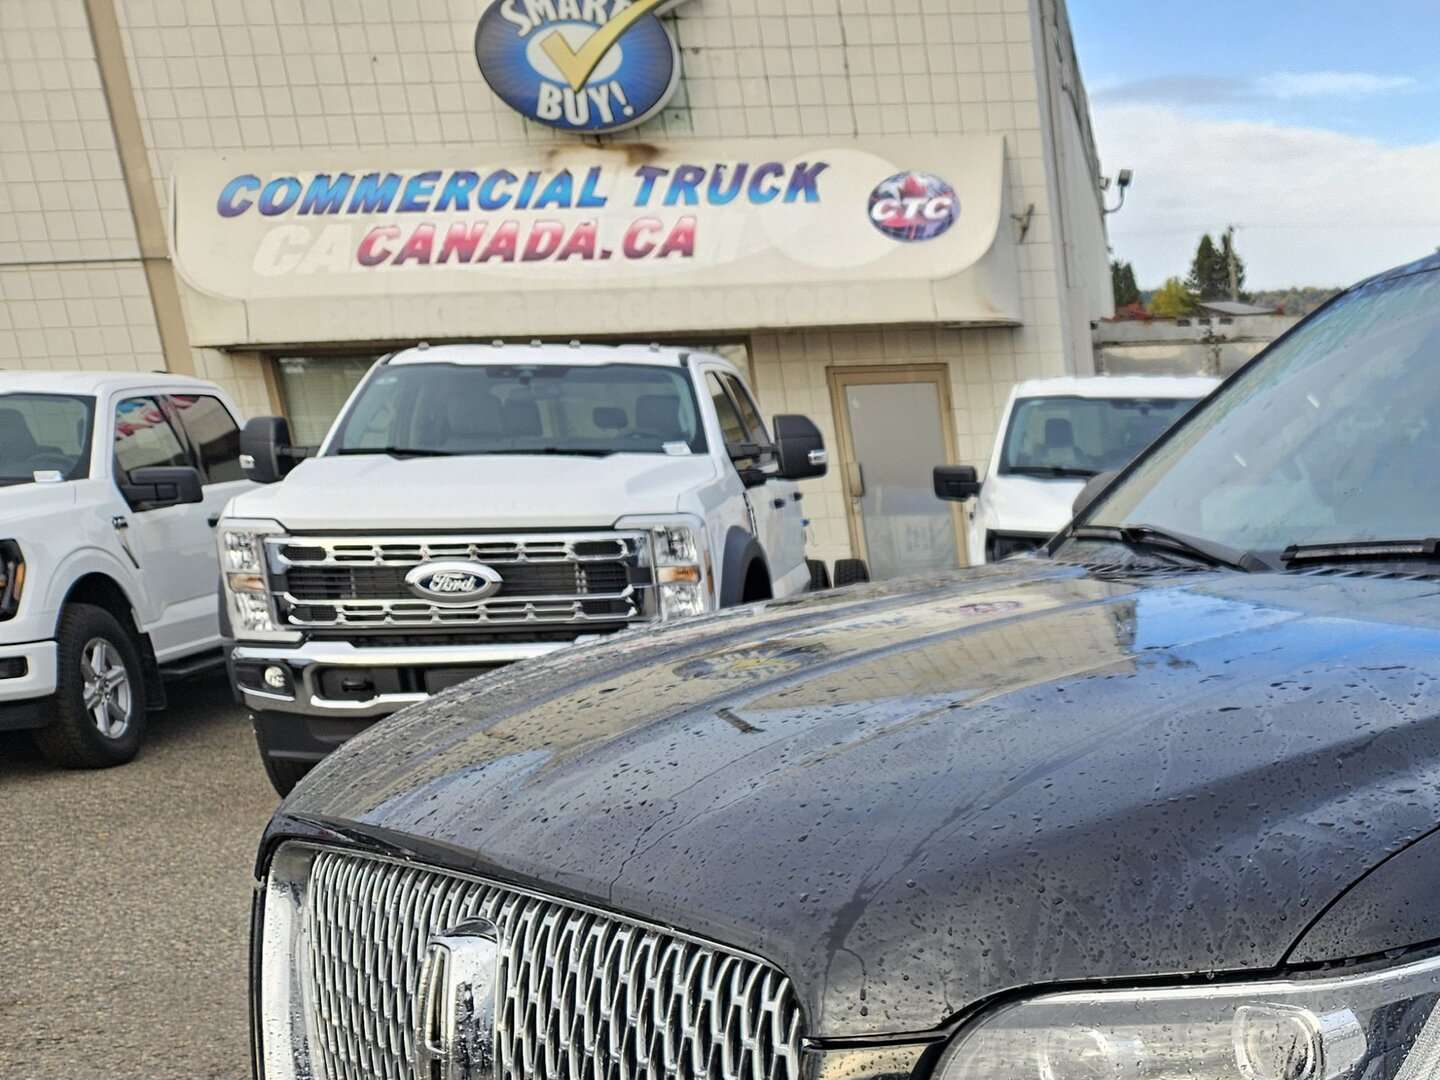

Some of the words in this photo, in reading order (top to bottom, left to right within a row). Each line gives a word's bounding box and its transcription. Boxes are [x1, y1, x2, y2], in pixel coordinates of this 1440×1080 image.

[536, 80, 634, 126] BUY!
[216, 165, 609, 218] COMMERCIAL
[633, 161, 830, 208] TRUCK
[871, 197, 952, 221] CTC
[356, 214, 698, 267] CANADA.CA
[429, 572, 477, 593] Ford
